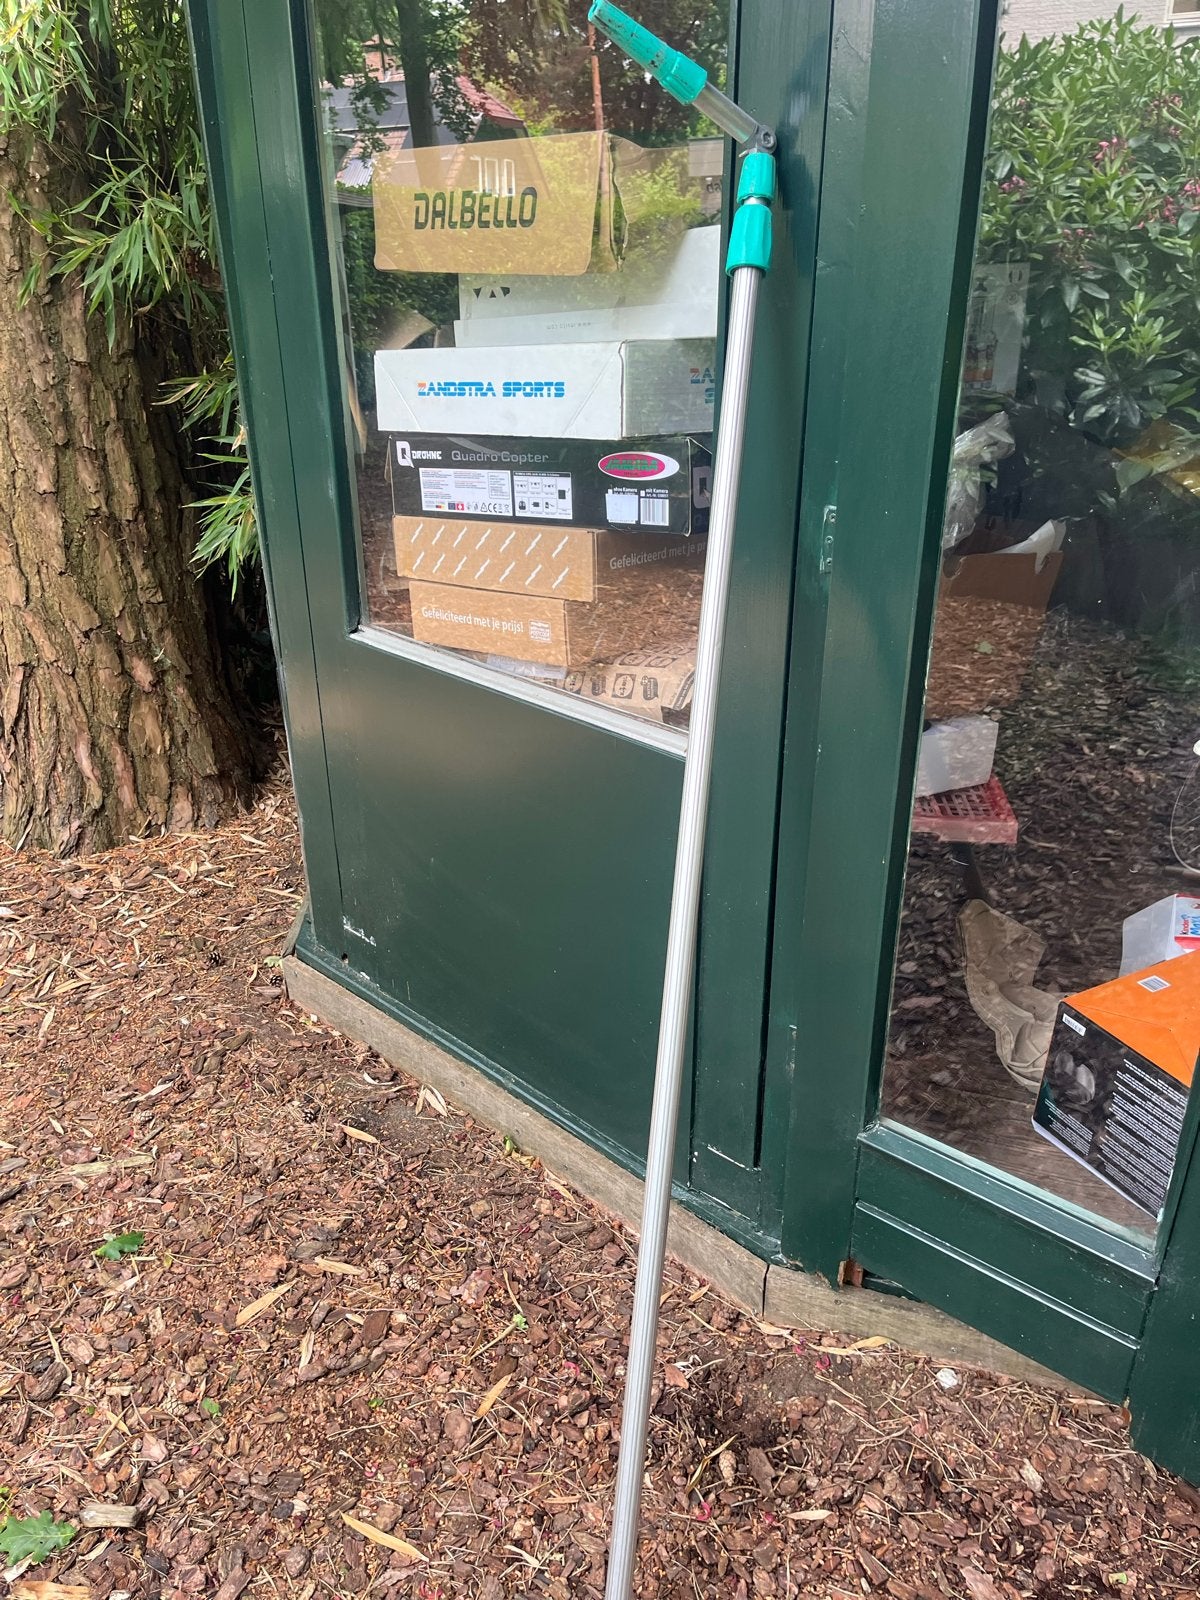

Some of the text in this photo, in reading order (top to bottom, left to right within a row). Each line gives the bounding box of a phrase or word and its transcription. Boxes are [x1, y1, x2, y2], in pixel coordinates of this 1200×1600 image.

[414, 187, 538, 230] DALBELLO
[417, 381, 565, 398] ZANDSTRA SPORTS
[451, 450, 549, 465] Quadro Copter
[609, 547, 667, 570] Gefeliciteerd
[668, 545, 686, 557] met
[421, 606, 472, 624] Gefeliciteerd
[473, 616, 491, 628] met
[491, 616, 501, 631] je
[502, 621, 524, 634] prijs!
